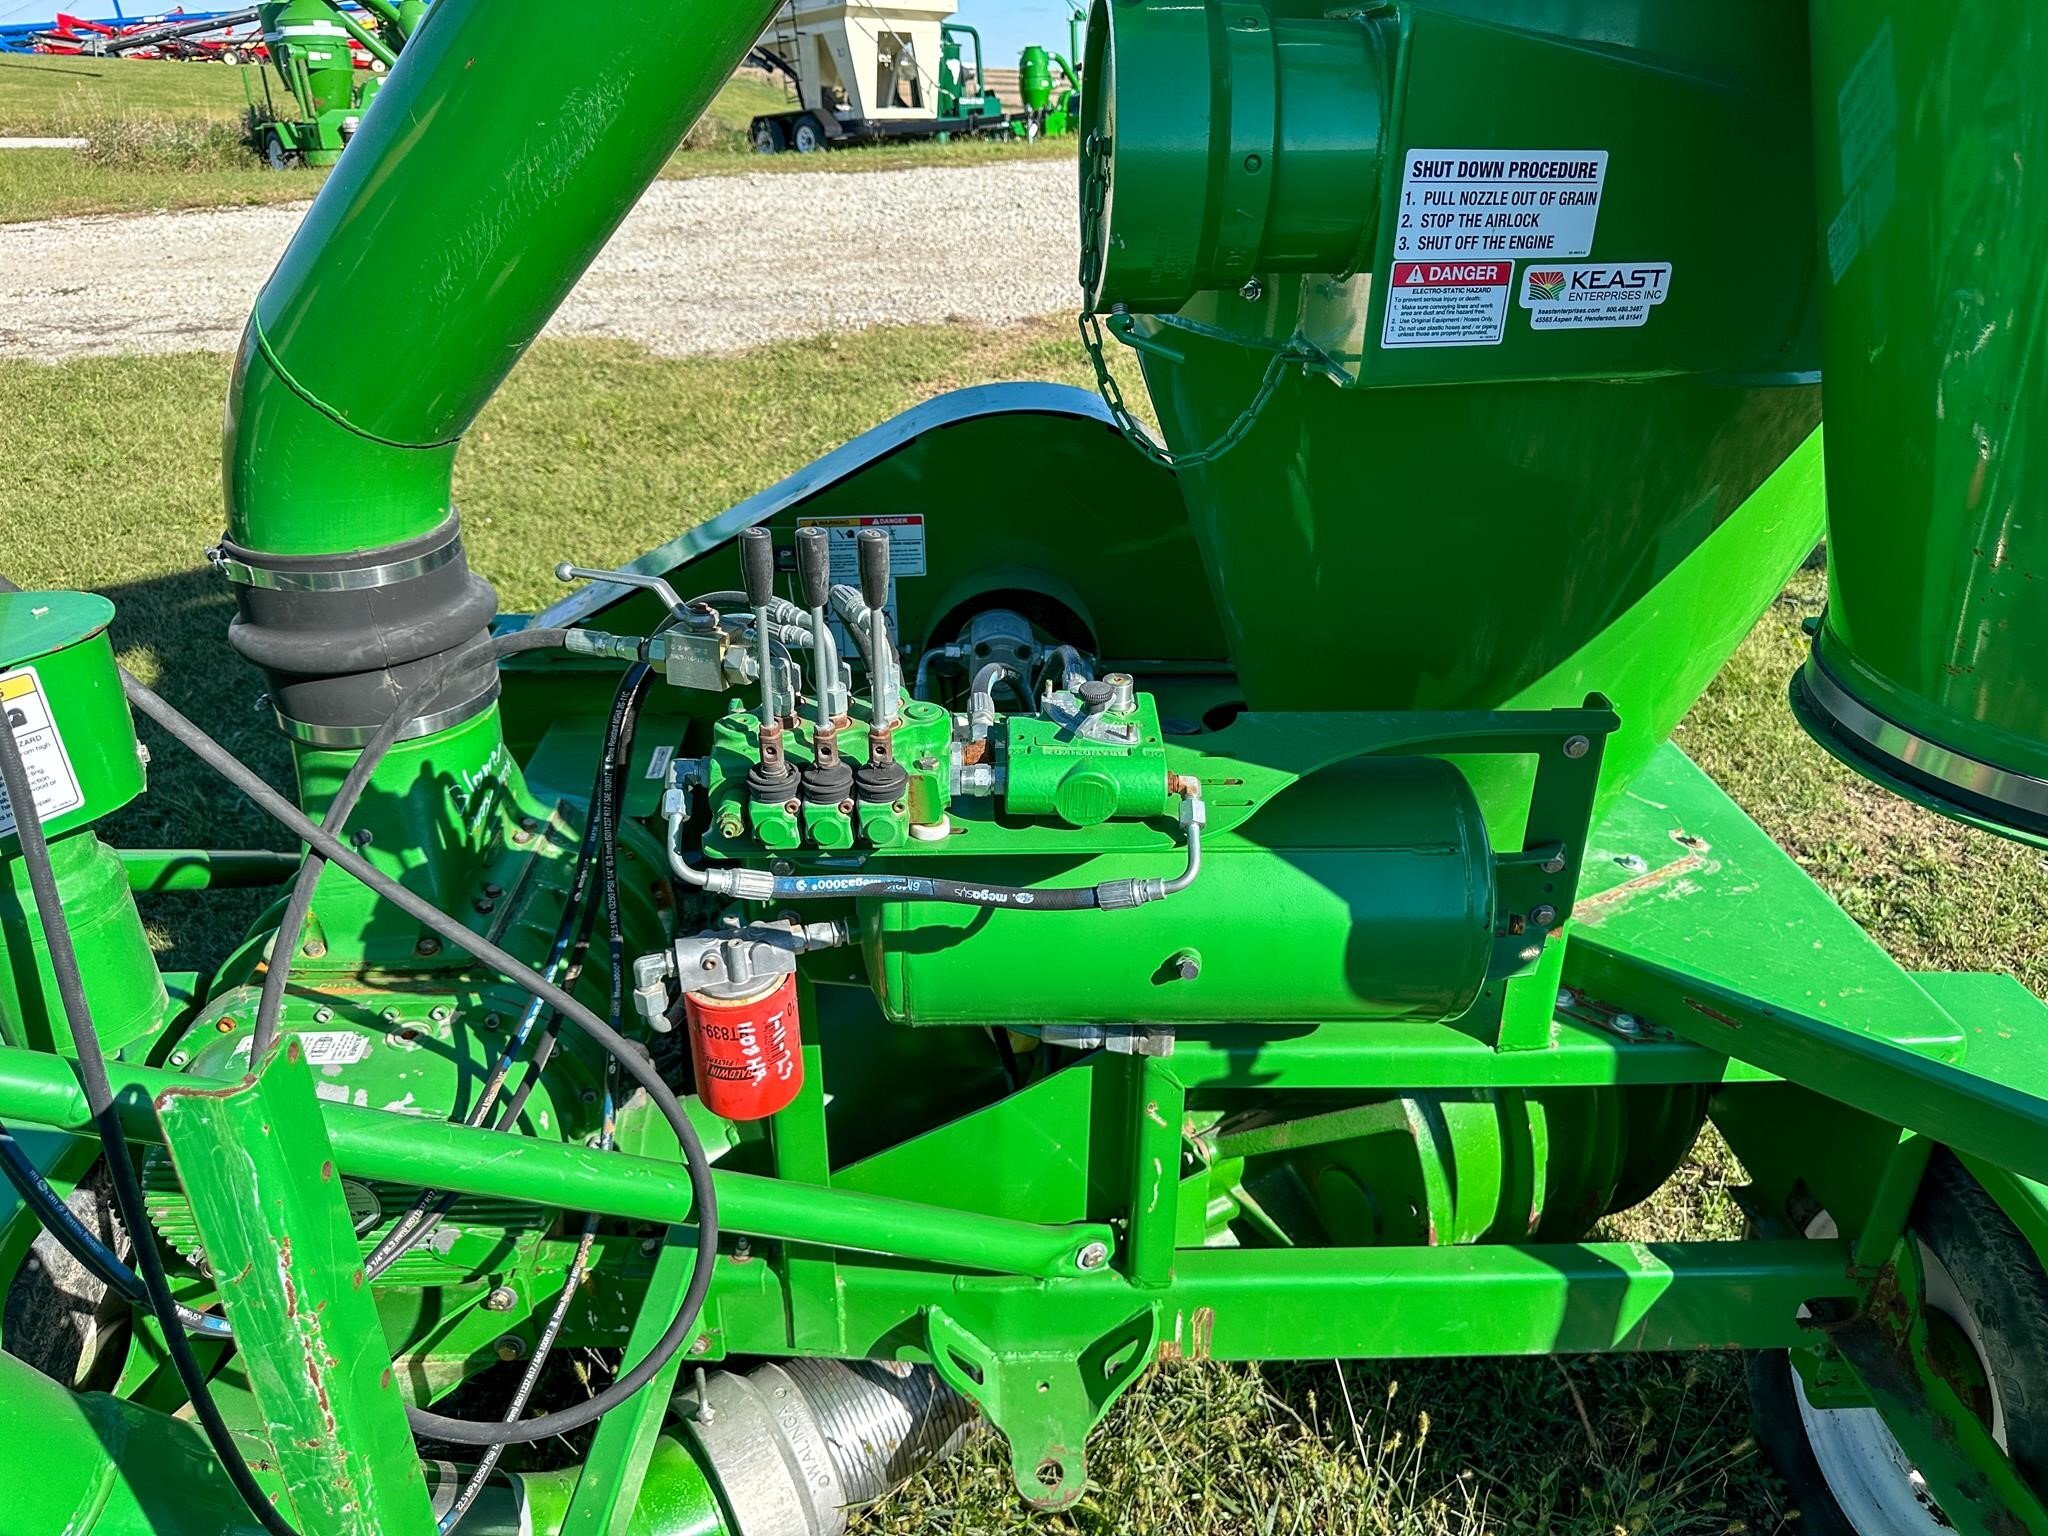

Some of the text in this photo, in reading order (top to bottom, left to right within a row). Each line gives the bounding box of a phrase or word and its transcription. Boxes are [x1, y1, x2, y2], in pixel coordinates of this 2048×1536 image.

[1412, 160, 1599, 179] SHUT DOWN PROCEDURE
[1405, 191, 1598, 206] 1. PULL NOZZLE OUT OF GRAIN
[1401, 214, 1540, 228] 2. STOP THE AIRLOCK
[1398, 235, 1554, 250] 3. SHUT OFF THE ENGINE
[1428, 266, 1498, 281] DANGER
[1570, 269, 1667, 290] KEAST
[1568, 290, 1662, 302] ENTERPRISES INC
[1538, 308, 1600, 316] keastenterprises.com
[1584, 314, 1617, 322] Henderson,
[19, 734, 42, 748] ZARD
[605, 723, 620, 747] Resistant
[602, 791, 612, 802] SAE
[602, 806, 612, 816] R17
[608, 909, 618, 924] MPa
[610, 924, 619, 935] 22.5
[381, 1238, 396, 1255] (6.3
[392, 1225, 408, 1243] mm)
[403, 1200, 428, 1230] ISO11237
[423, 1190, 436, 1204] R17
[552, 1300, 566, 1319] Flame
[537, 1329, 554, 1351] 100R17
[532, 1349, 545, 1364] SAE
[525, 1366, 538, 1380] R17
[512, 1378, 533, 1407] ISO11237
[775, 1401, 823, 1482] WALINGA
[454, 1494, 468, 1511] 22.5
[463, 1480, 478, 1498] MPa
[471, 1462, 488, 1483] (3250
